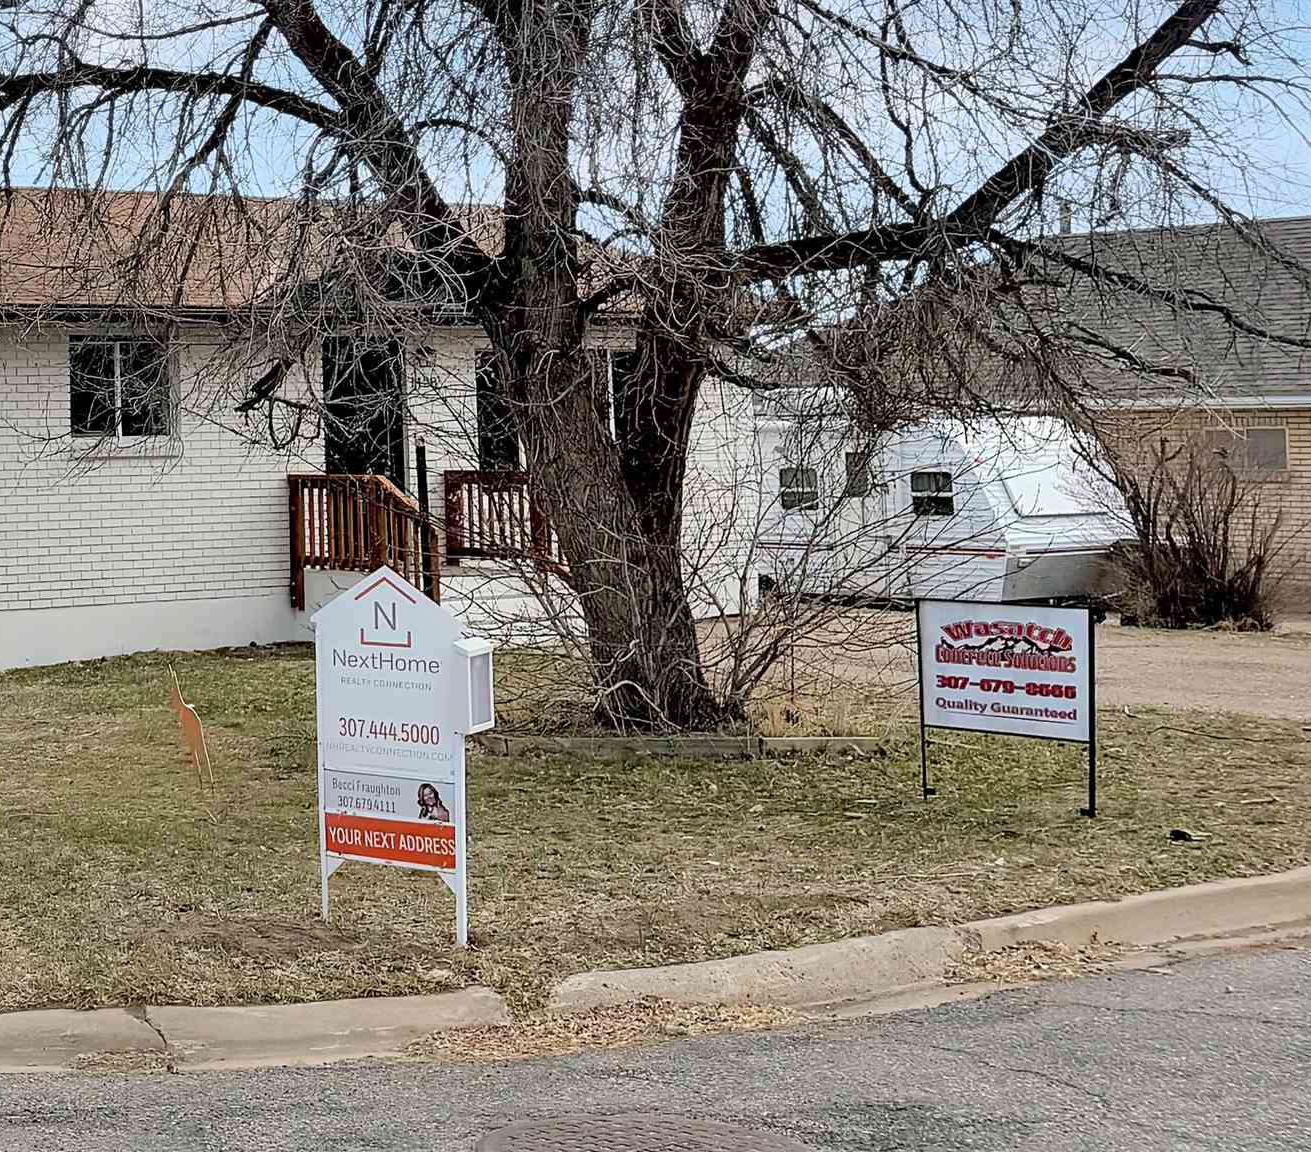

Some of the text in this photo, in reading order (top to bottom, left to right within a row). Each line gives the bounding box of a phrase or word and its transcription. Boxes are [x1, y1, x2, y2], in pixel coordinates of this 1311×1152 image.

[374, 601, 396, 631] N
[940, 620, 1073, 649] Wasatch
[332, 648, 440, 674] NextHome
[373, 679, 432, 692] CONNECTION
[935, 697, 1077, 720] Quality Guaranteed
[338, 717, 440, 746] 307.444.5000
[330, 827, 455, 856] YOUR NEXT ADDRESS
